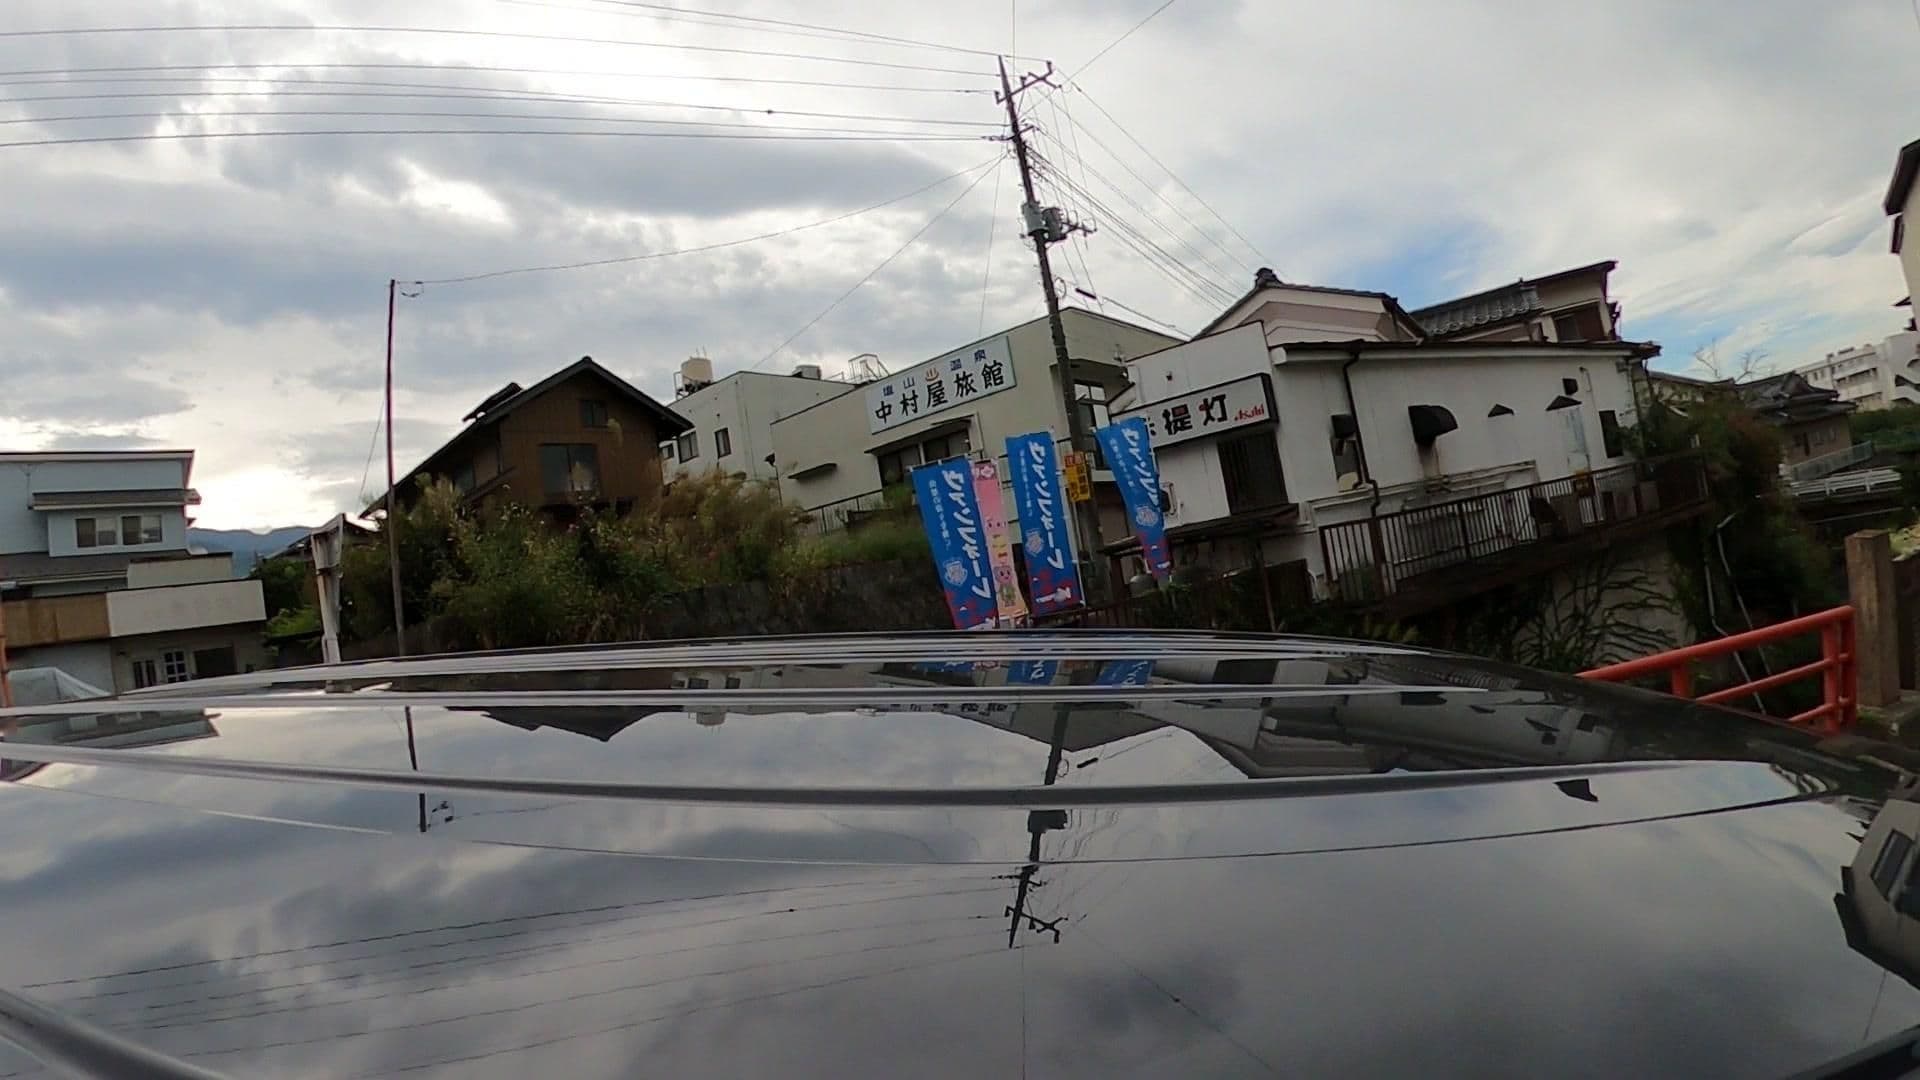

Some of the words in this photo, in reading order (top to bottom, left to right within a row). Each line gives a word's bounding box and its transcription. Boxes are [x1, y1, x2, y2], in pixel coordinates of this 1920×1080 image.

[874, 359, 1004, 425] 中村屋旅館
